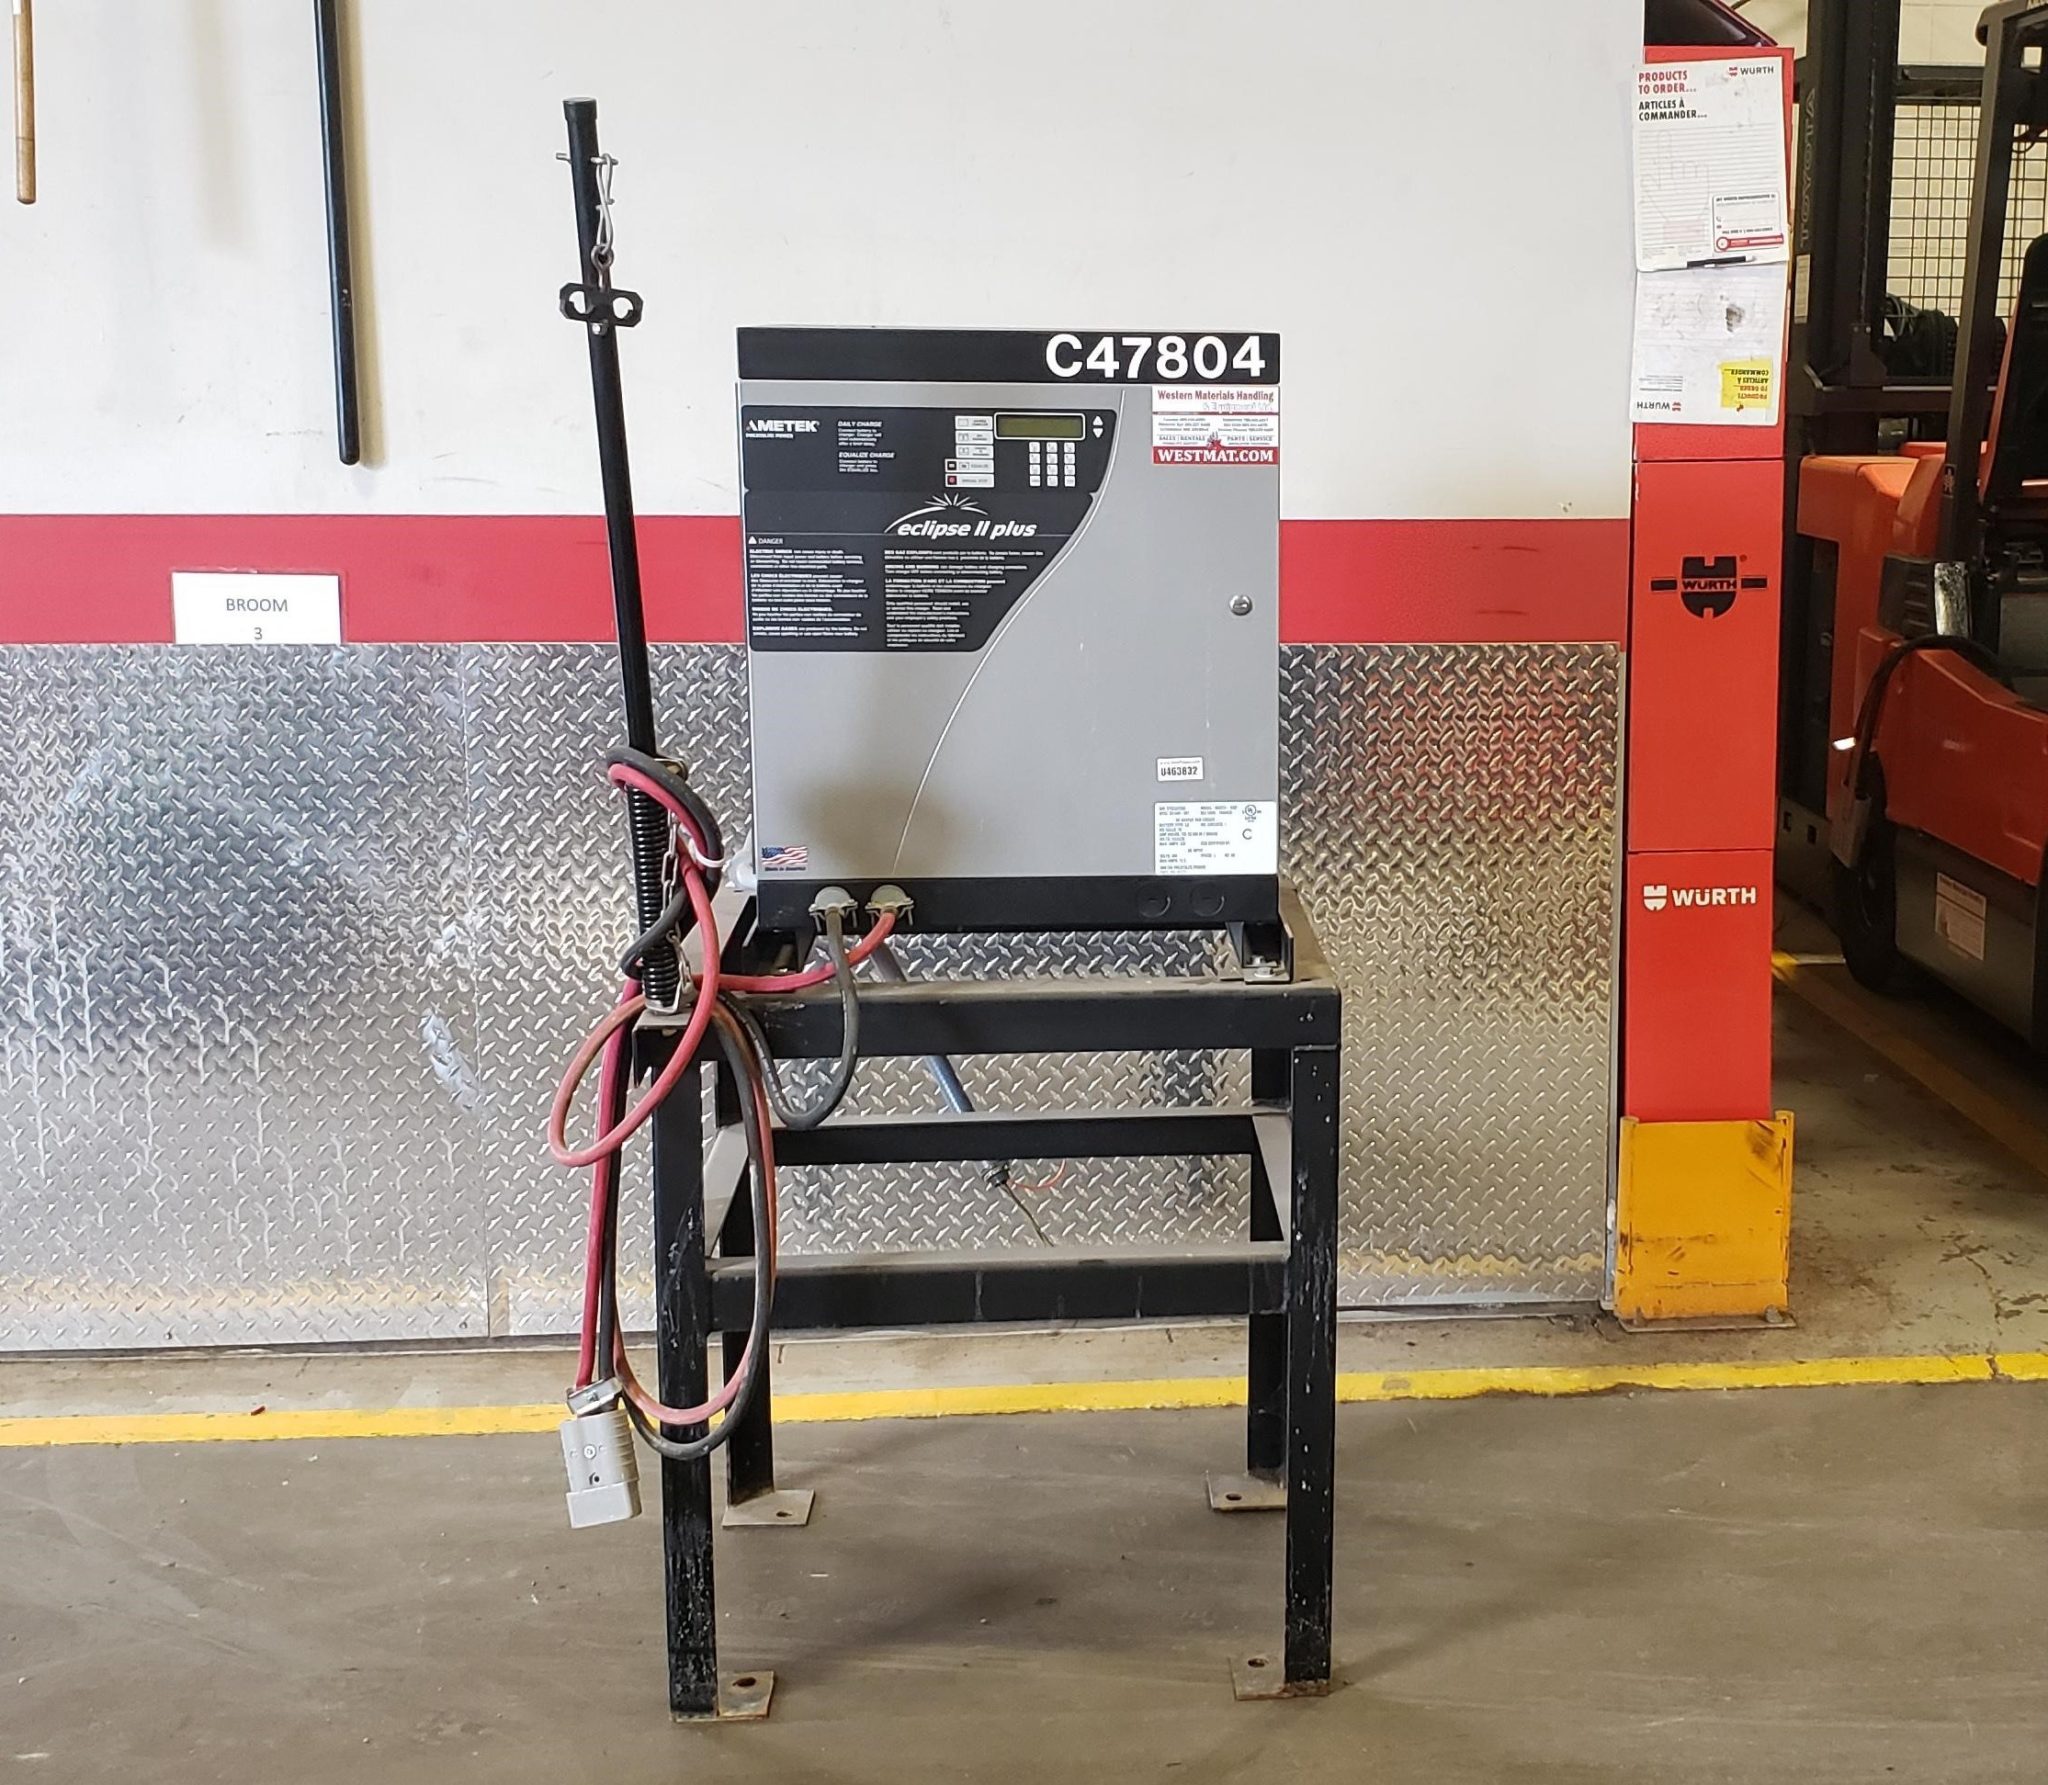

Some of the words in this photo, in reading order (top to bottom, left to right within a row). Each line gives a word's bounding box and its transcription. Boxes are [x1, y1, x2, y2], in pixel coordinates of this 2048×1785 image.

[1638, 70, 1688, 83] PRODUCTS
[1638, 85, 1650, 94] TO
[1653, 83, 1697, 94] ORDER...
[1638, 100, 1676, 111] ARTICLES
[1678, 97, 1685, 108] À
[1638, 110, 1708, 121] COMMANDER...
[1801, 88, 1816, 248] TOYOTA
[1046, 333, 1266, 379] C47804
[1158, 390, 1193, 400] Western
[1195, 390, 1235, 400] Materials
[1236, 391, 1274, 402] Handling
[746, 420, 818, 432] AMETEK
[1157, 449, 1274, 462] WESTMAT.COM
[897, 520, 971, 540] eclipse
[989, 520, 1037, 540] plus
[226, 598, 288, 612] BROOM
[254, 627, 263, 640] 3
[1671, 886, 1756, 907] WÜRTH
